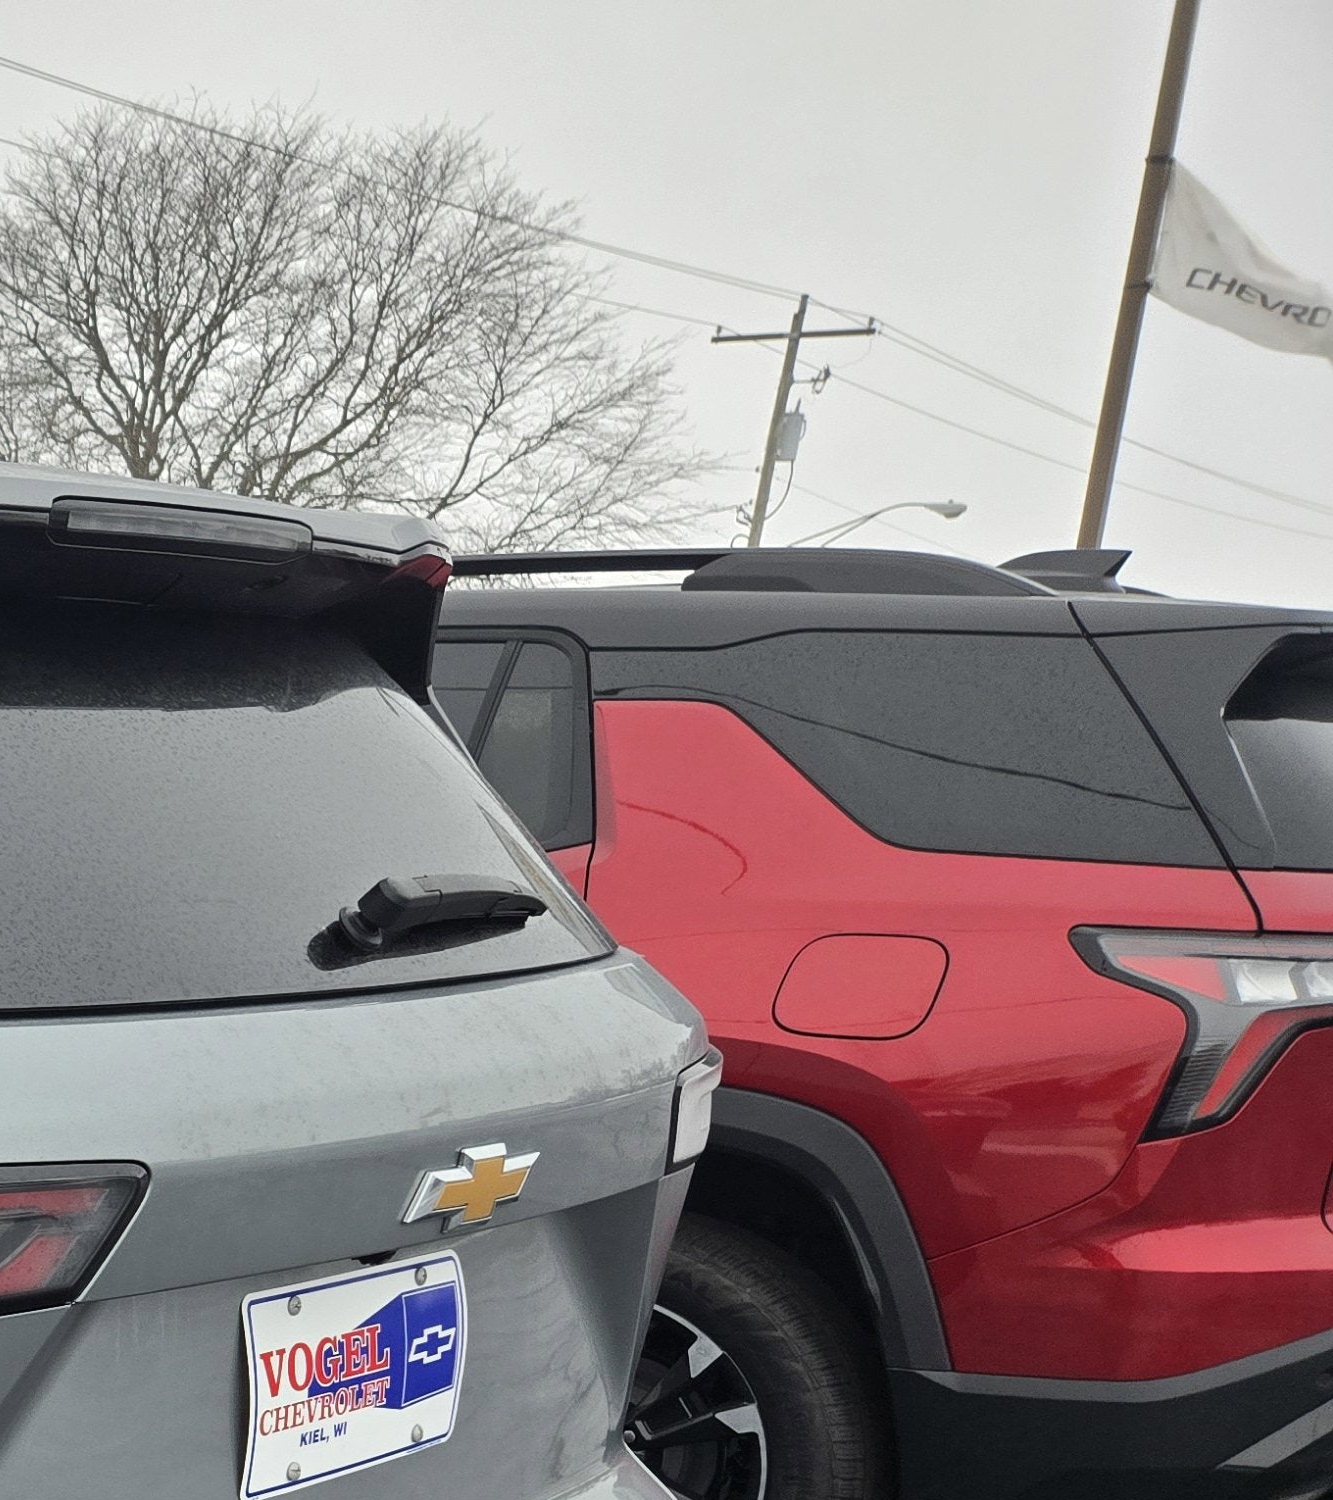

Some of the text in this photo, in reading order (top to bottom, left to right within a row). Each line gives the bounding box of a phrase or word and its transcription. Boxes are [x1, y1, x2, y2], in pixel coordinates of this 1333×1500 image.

[259, 1324, 390, 1397] VOGEL
[259, 1377, 389, 1436] CHEVROLET
[299, 1421, 348, 1447] KIEL, WI
